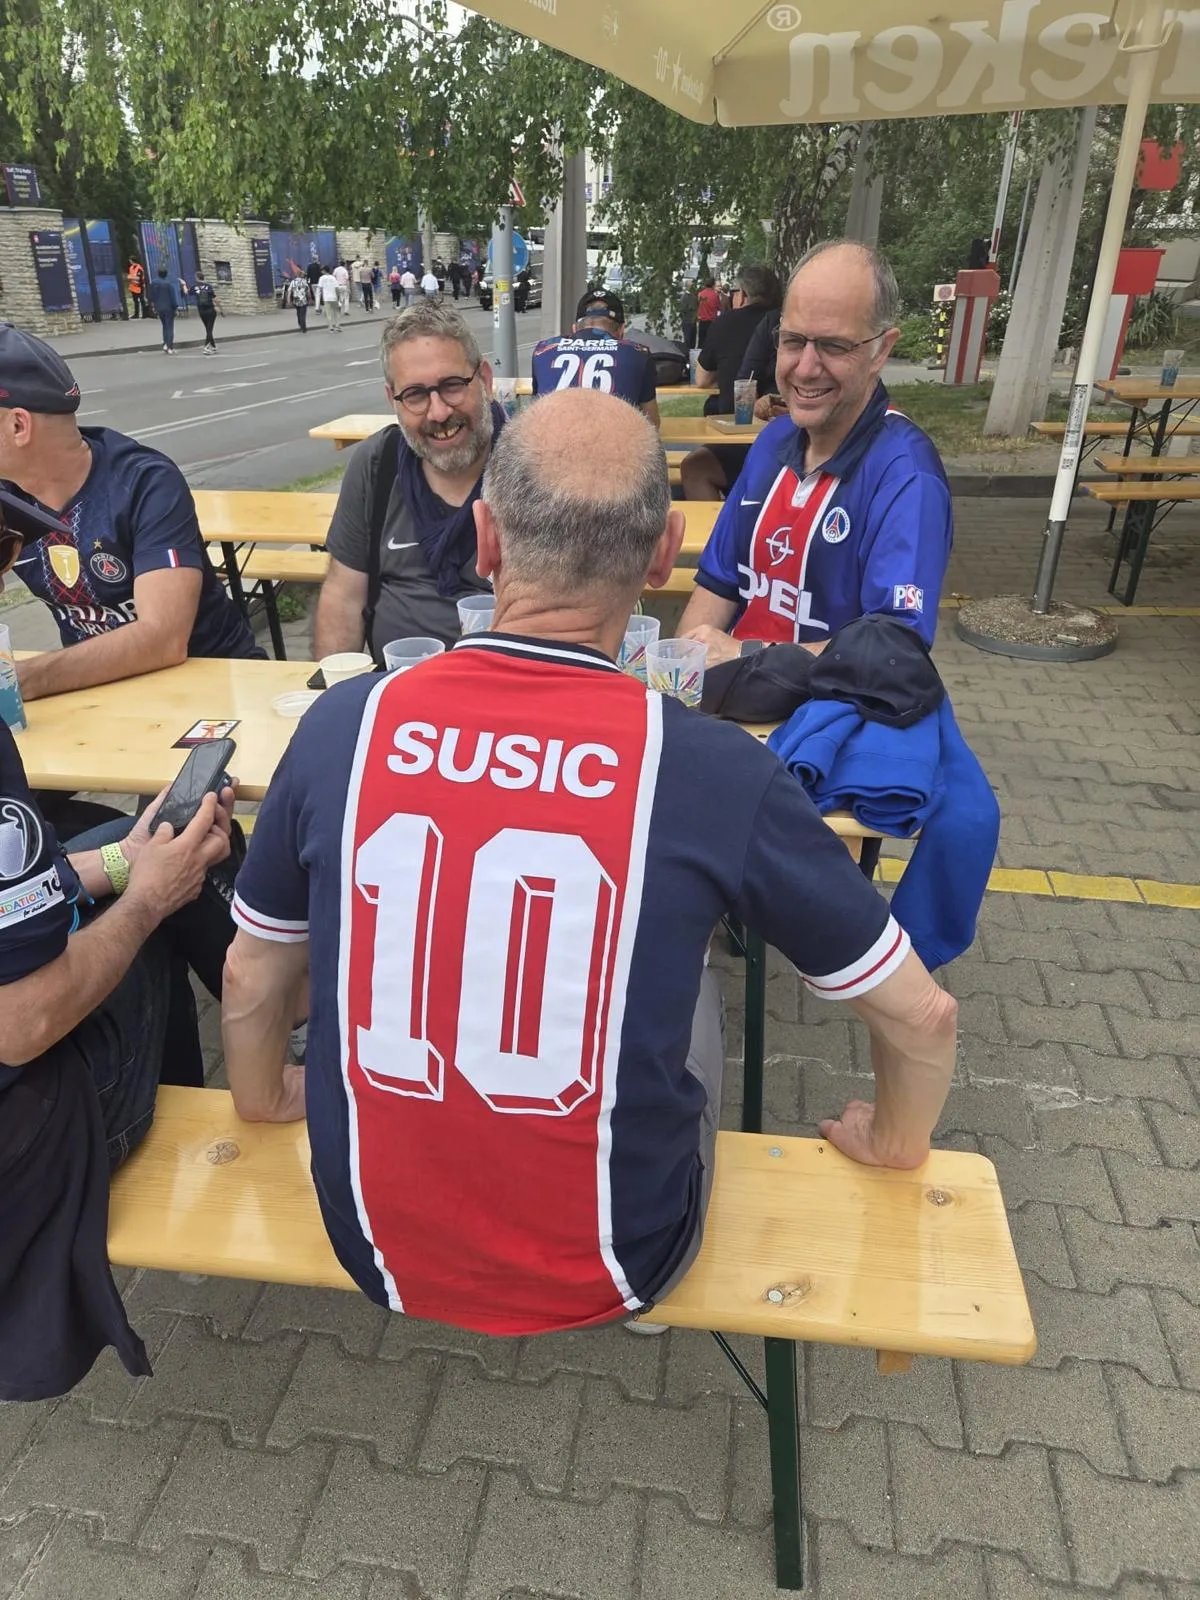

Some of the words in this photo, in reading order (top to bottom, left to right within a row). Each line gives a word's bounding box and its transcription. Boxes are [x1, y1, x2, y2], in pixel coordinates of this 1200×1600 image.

[558, 338, 618, 347] PARIS
[551, 353, 616, 394] 26
[894, 585, 924, 612] PSG
[386, 720, 619, 798] SUSIC
[354, 812, 618, 1116] 10
